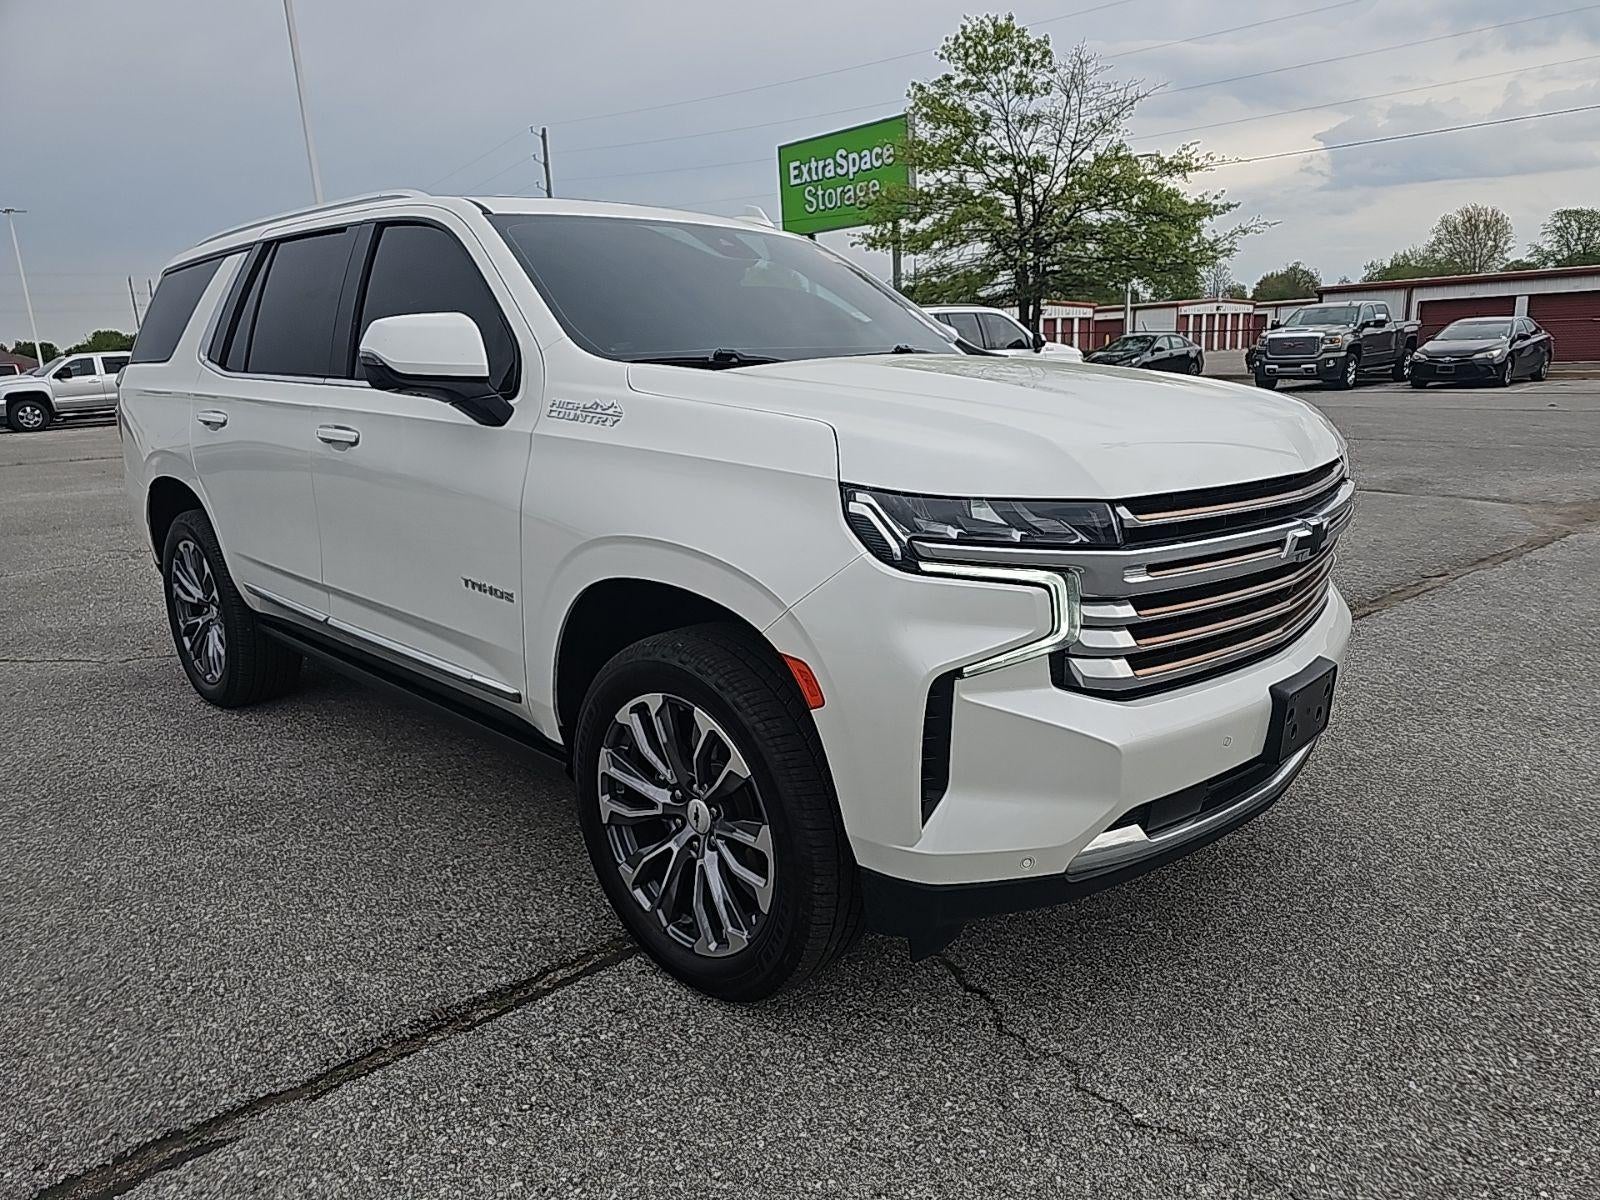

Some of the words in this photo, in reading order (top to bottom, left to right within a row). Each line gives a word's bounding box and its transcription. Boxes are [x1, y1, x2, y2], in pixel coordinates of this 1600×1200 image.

[789, 143, 895, 186] ExtraSpace
[804, 179, 880, 213] Storage
[547, 409, 621, 427] COUNTRY
[460, 576, 515, 604] TAHOE
